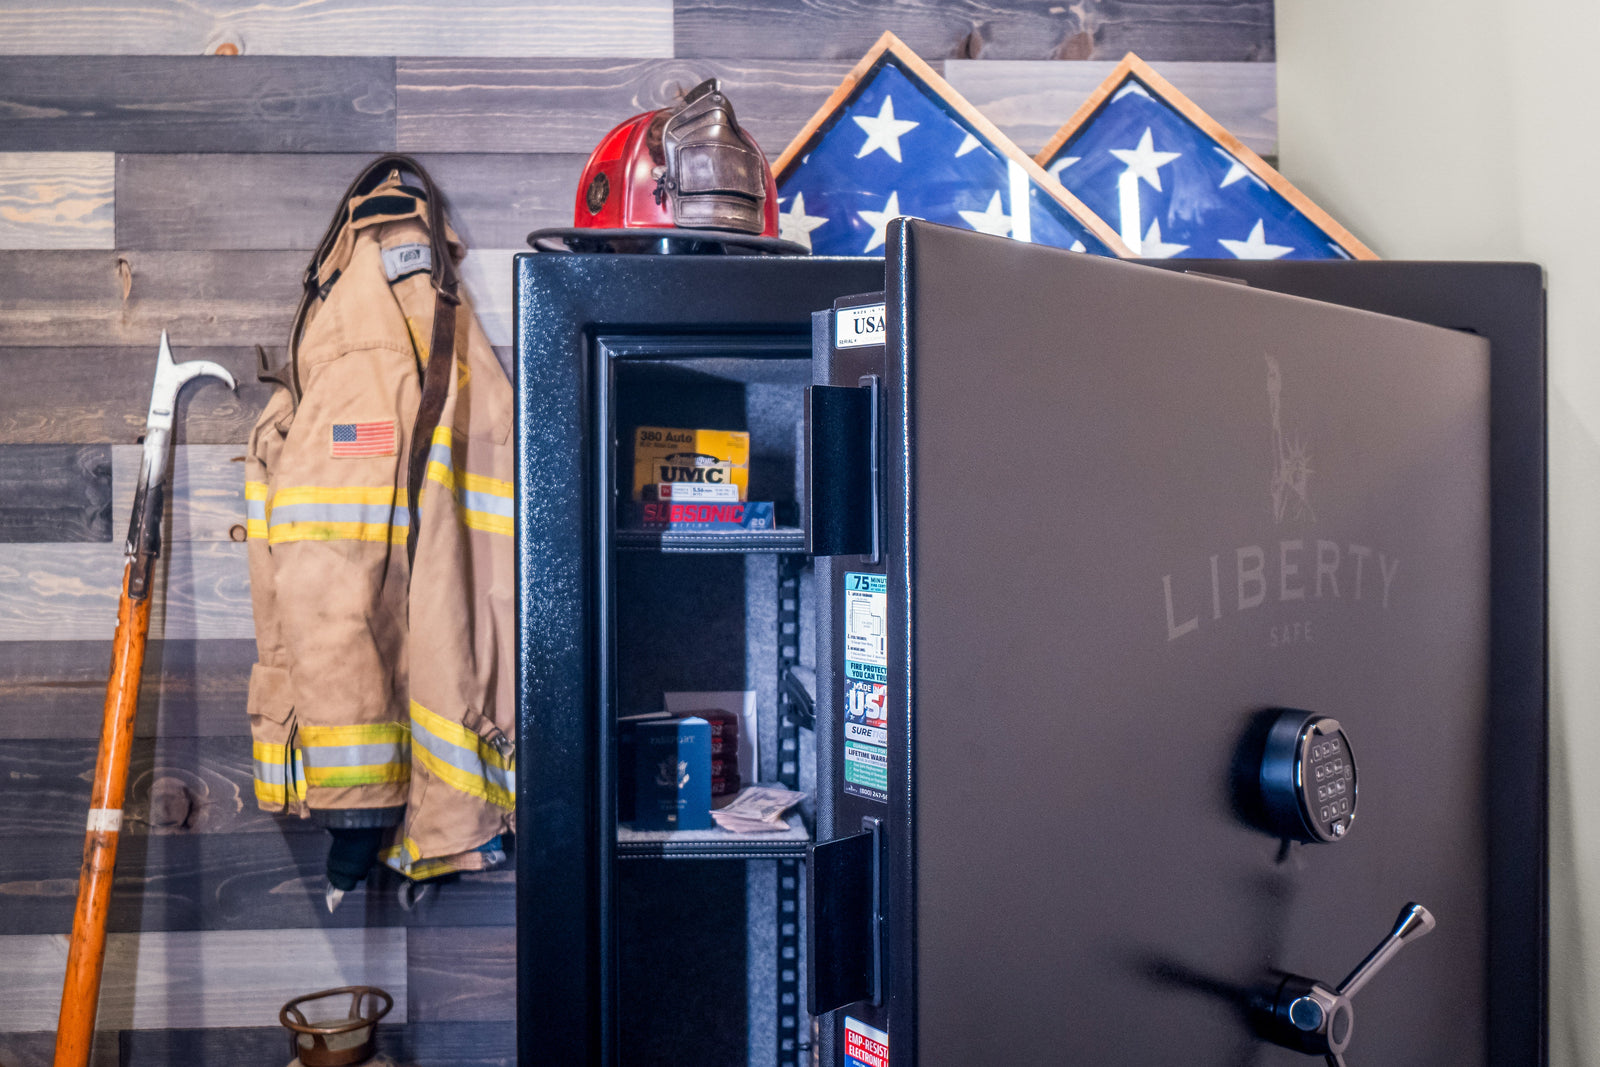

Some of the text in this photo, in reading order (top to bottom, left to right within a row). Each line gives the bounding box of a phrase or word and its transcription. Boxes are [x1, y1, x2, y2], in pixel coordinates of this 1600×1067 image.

[853, 316, 886, 334] USA
[640, 431, 693, 443] 380 Auto
[660, 466, 724, 484] UMC
[643, 504, 745, 524] SUBSONIC
[751, 518, 766, 527] 20
[854, 575, 870, 591] 75
[1162, 539, 1400, 642] LIBERTY
[1270, 621, 1314, 648] SAFE
[850, 662, 863, 671] FIRE
[852, 670, 864, 679] YOU
[864, 672, 876, 680] CAN
[853, 682, 872, 693] MADE
[848, 748, 870, 760] LIFETIME
